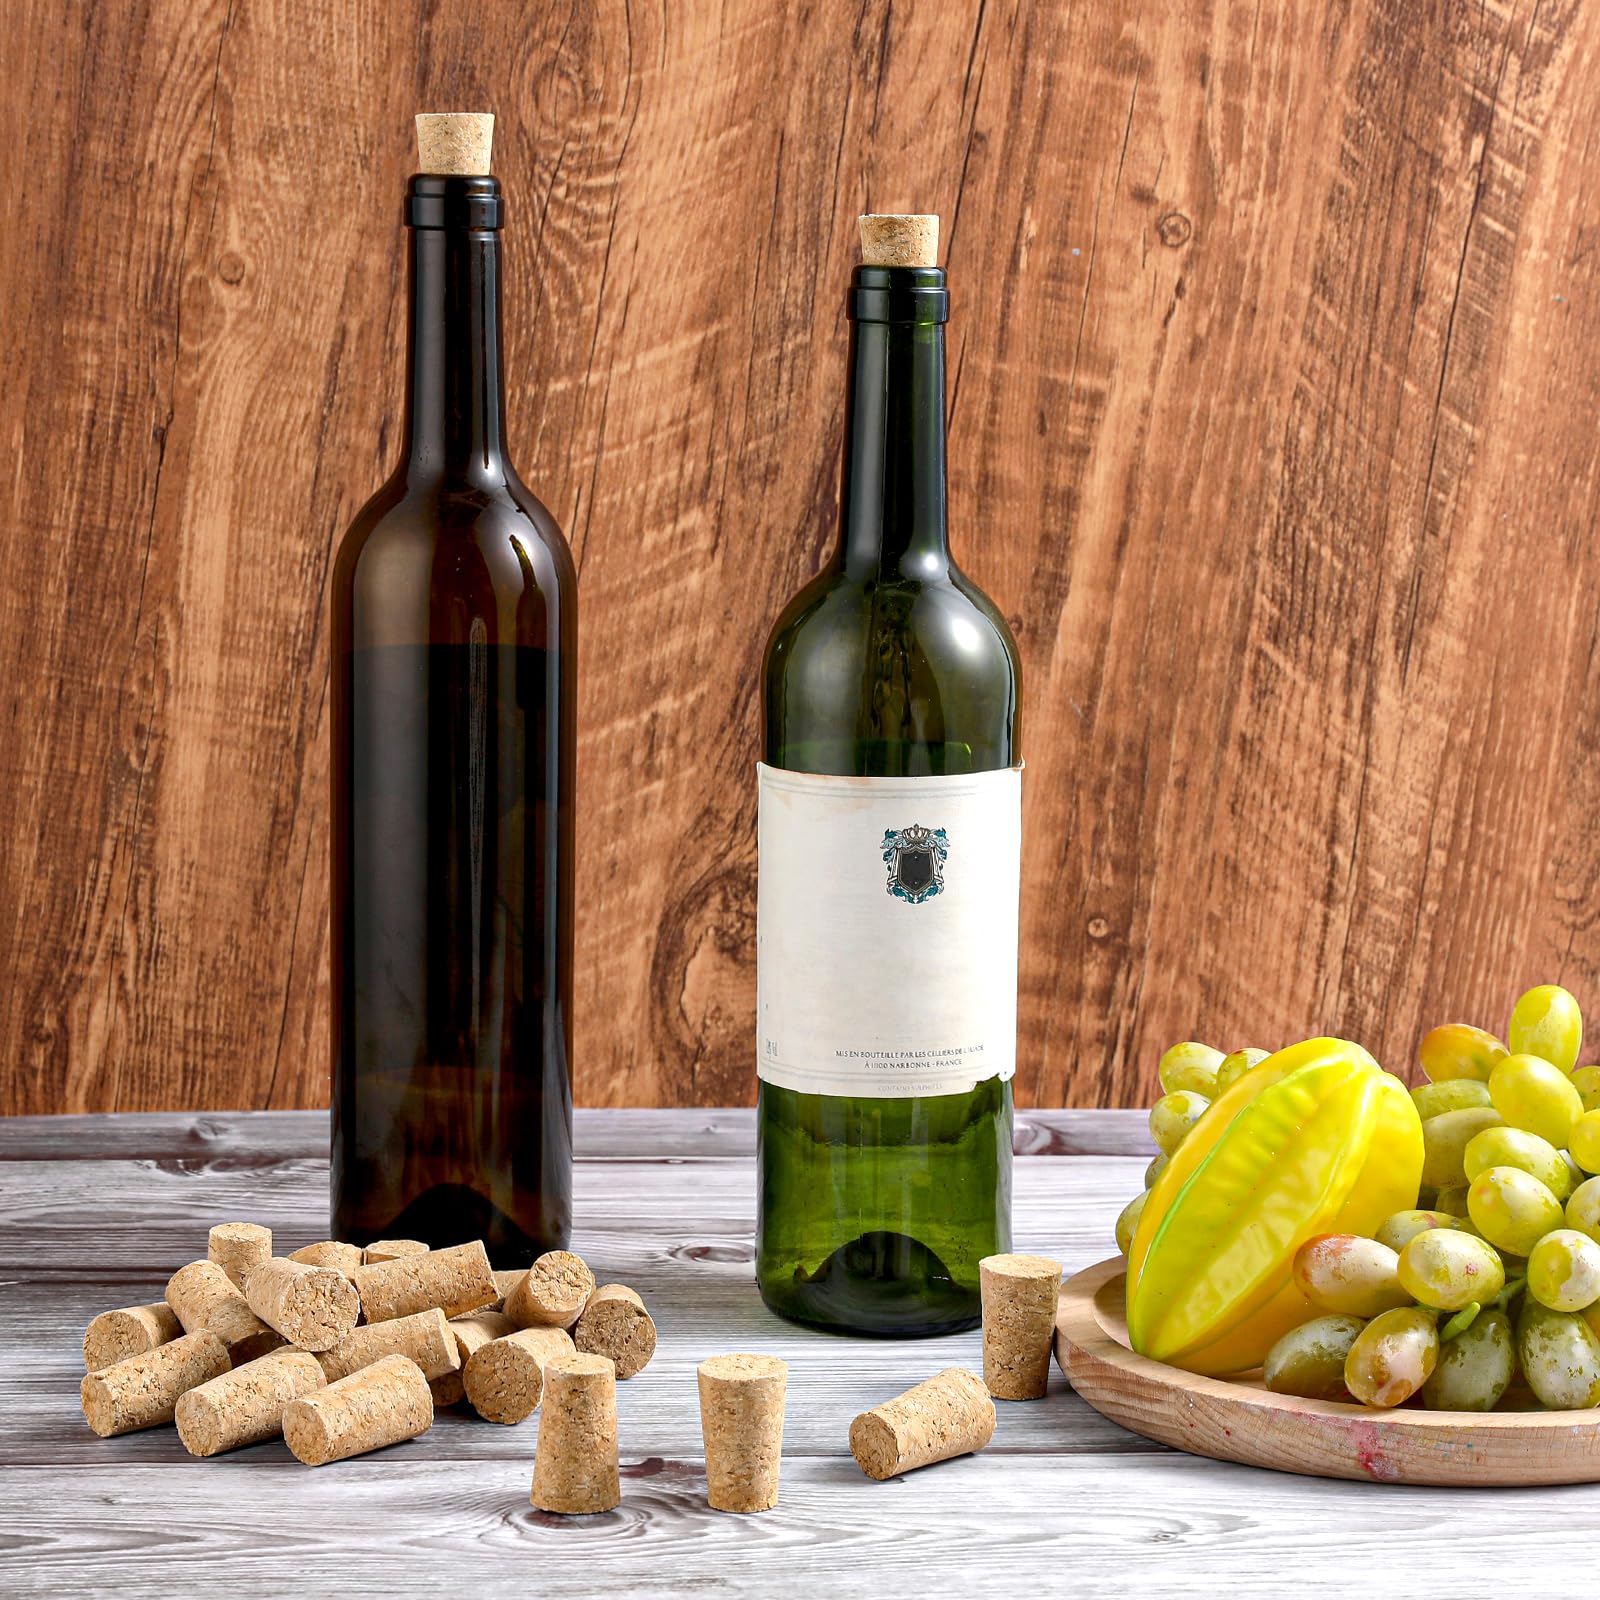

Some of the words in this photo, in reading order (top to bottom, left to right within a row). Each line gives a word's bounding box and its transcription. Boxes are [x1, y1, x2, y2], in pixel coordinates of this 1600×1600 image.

[835, 1050, 848, 1058] MIS
[849, 1050, 859, 1058] EN
[860, 1051, 900, 1060] BOUTEILLE
[900, 1051, 914, 1060] PAR
[889, 1061, 930, 1069] NARBONNE
[936, 1058, 962, 1067] FRANCE
